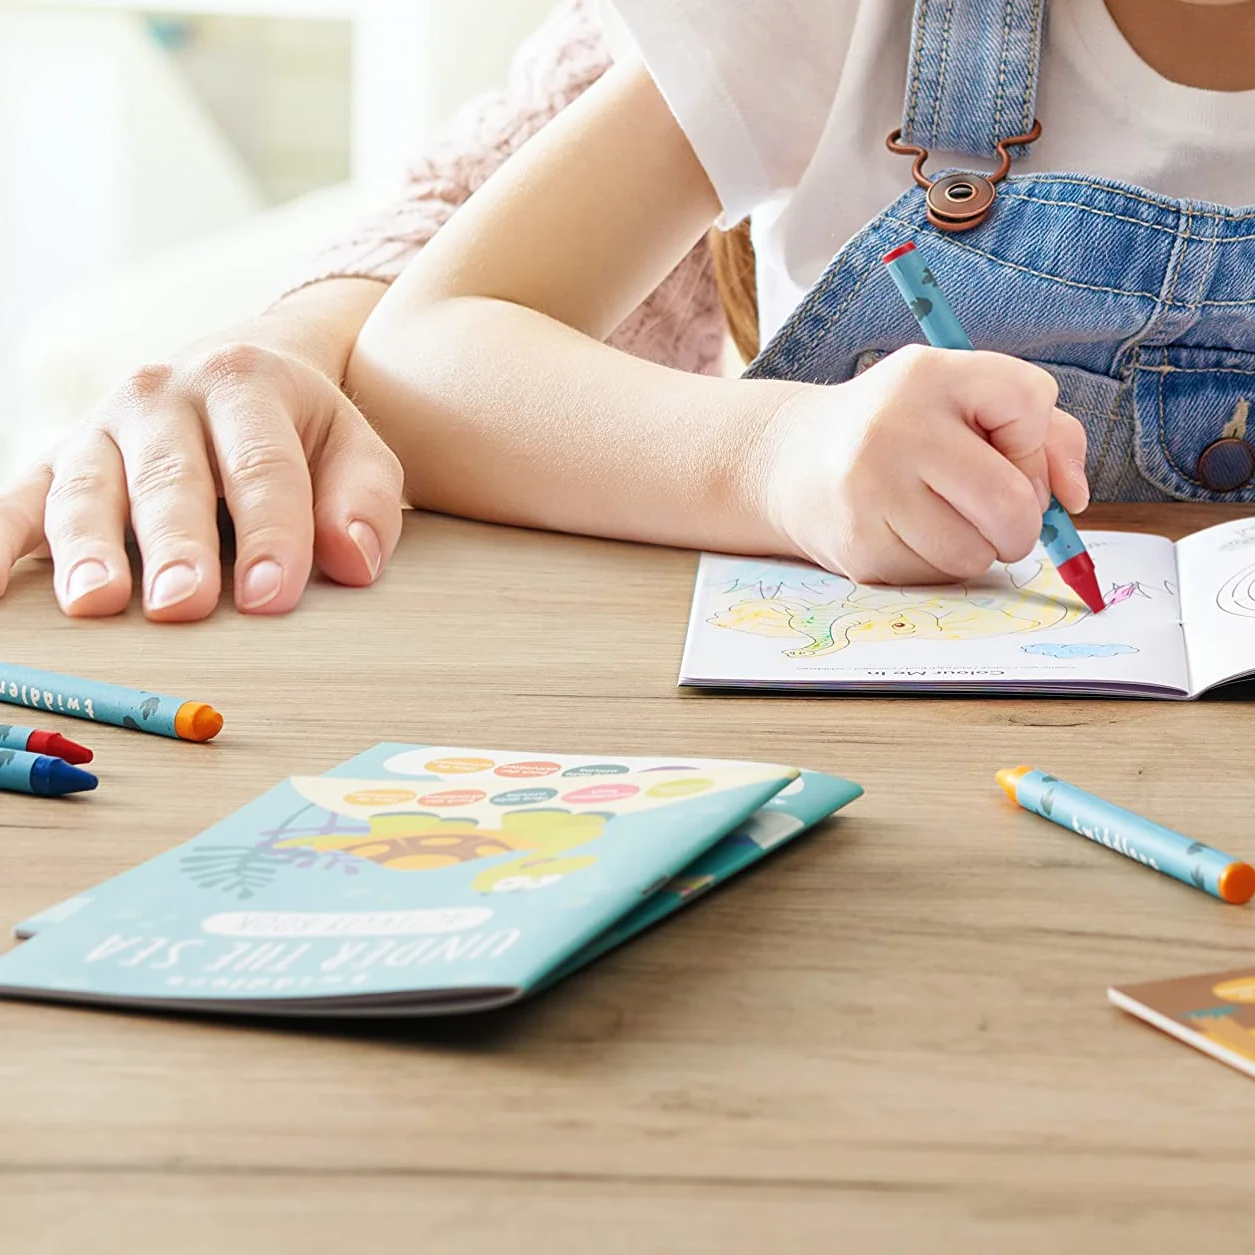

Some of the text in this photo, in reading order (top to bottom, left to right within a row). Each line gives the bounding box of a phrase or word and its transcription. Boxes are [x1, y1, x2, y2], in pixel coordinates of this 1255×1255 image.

[82, 928, 521, 973] UNDER THE SEA
